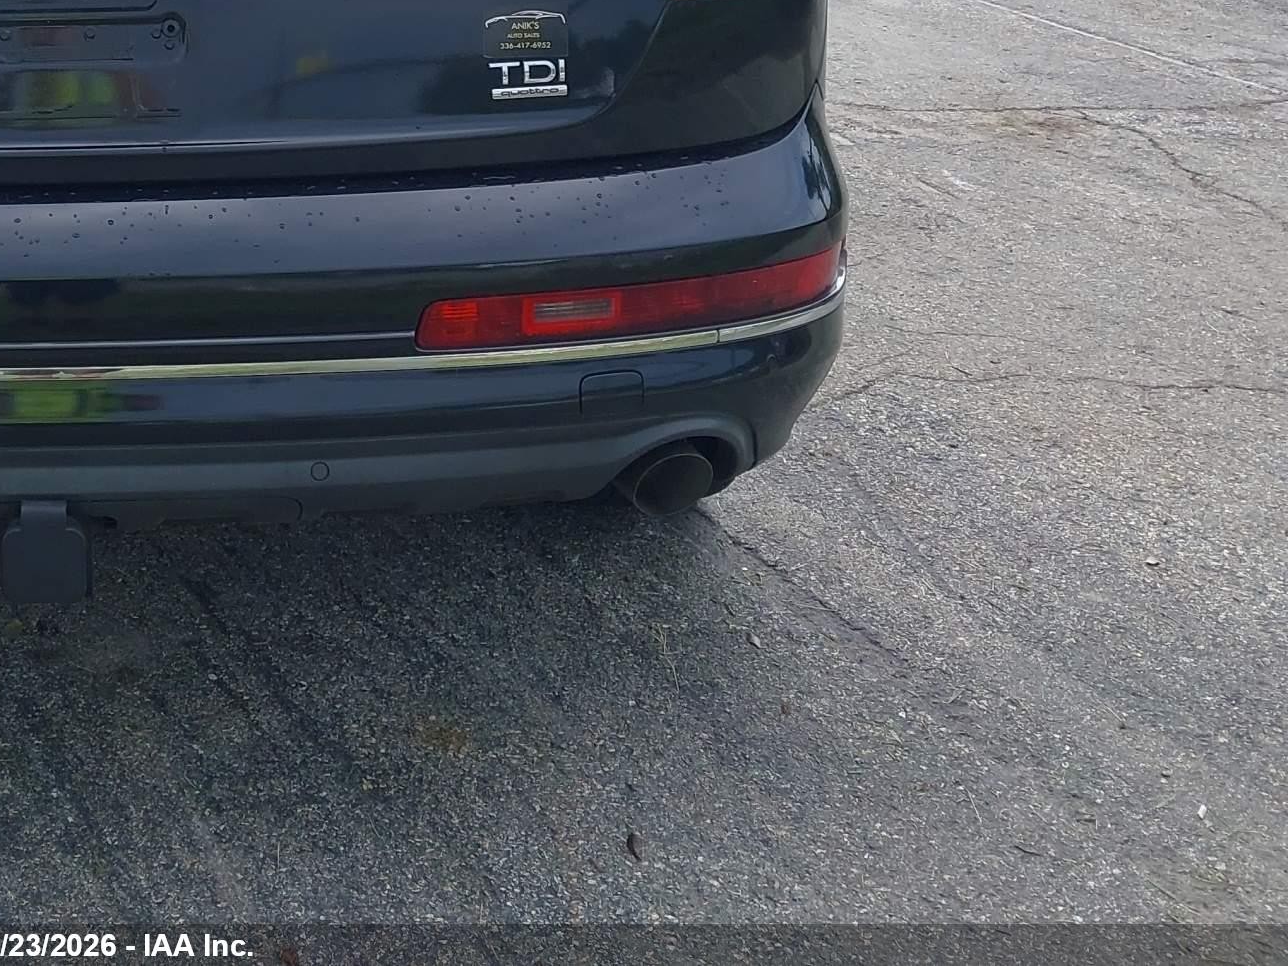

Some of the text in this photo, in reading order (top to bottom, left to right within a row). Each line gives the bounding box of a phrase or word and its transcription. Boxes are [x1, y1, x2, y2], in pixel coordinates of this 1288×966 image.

[511, 20, 540, 30] ANIK'S
[499, 41, 552, 50] 336-417-6952
[487, 58, 566, 86] TDI
[500, 88, 560, 98] quattro
